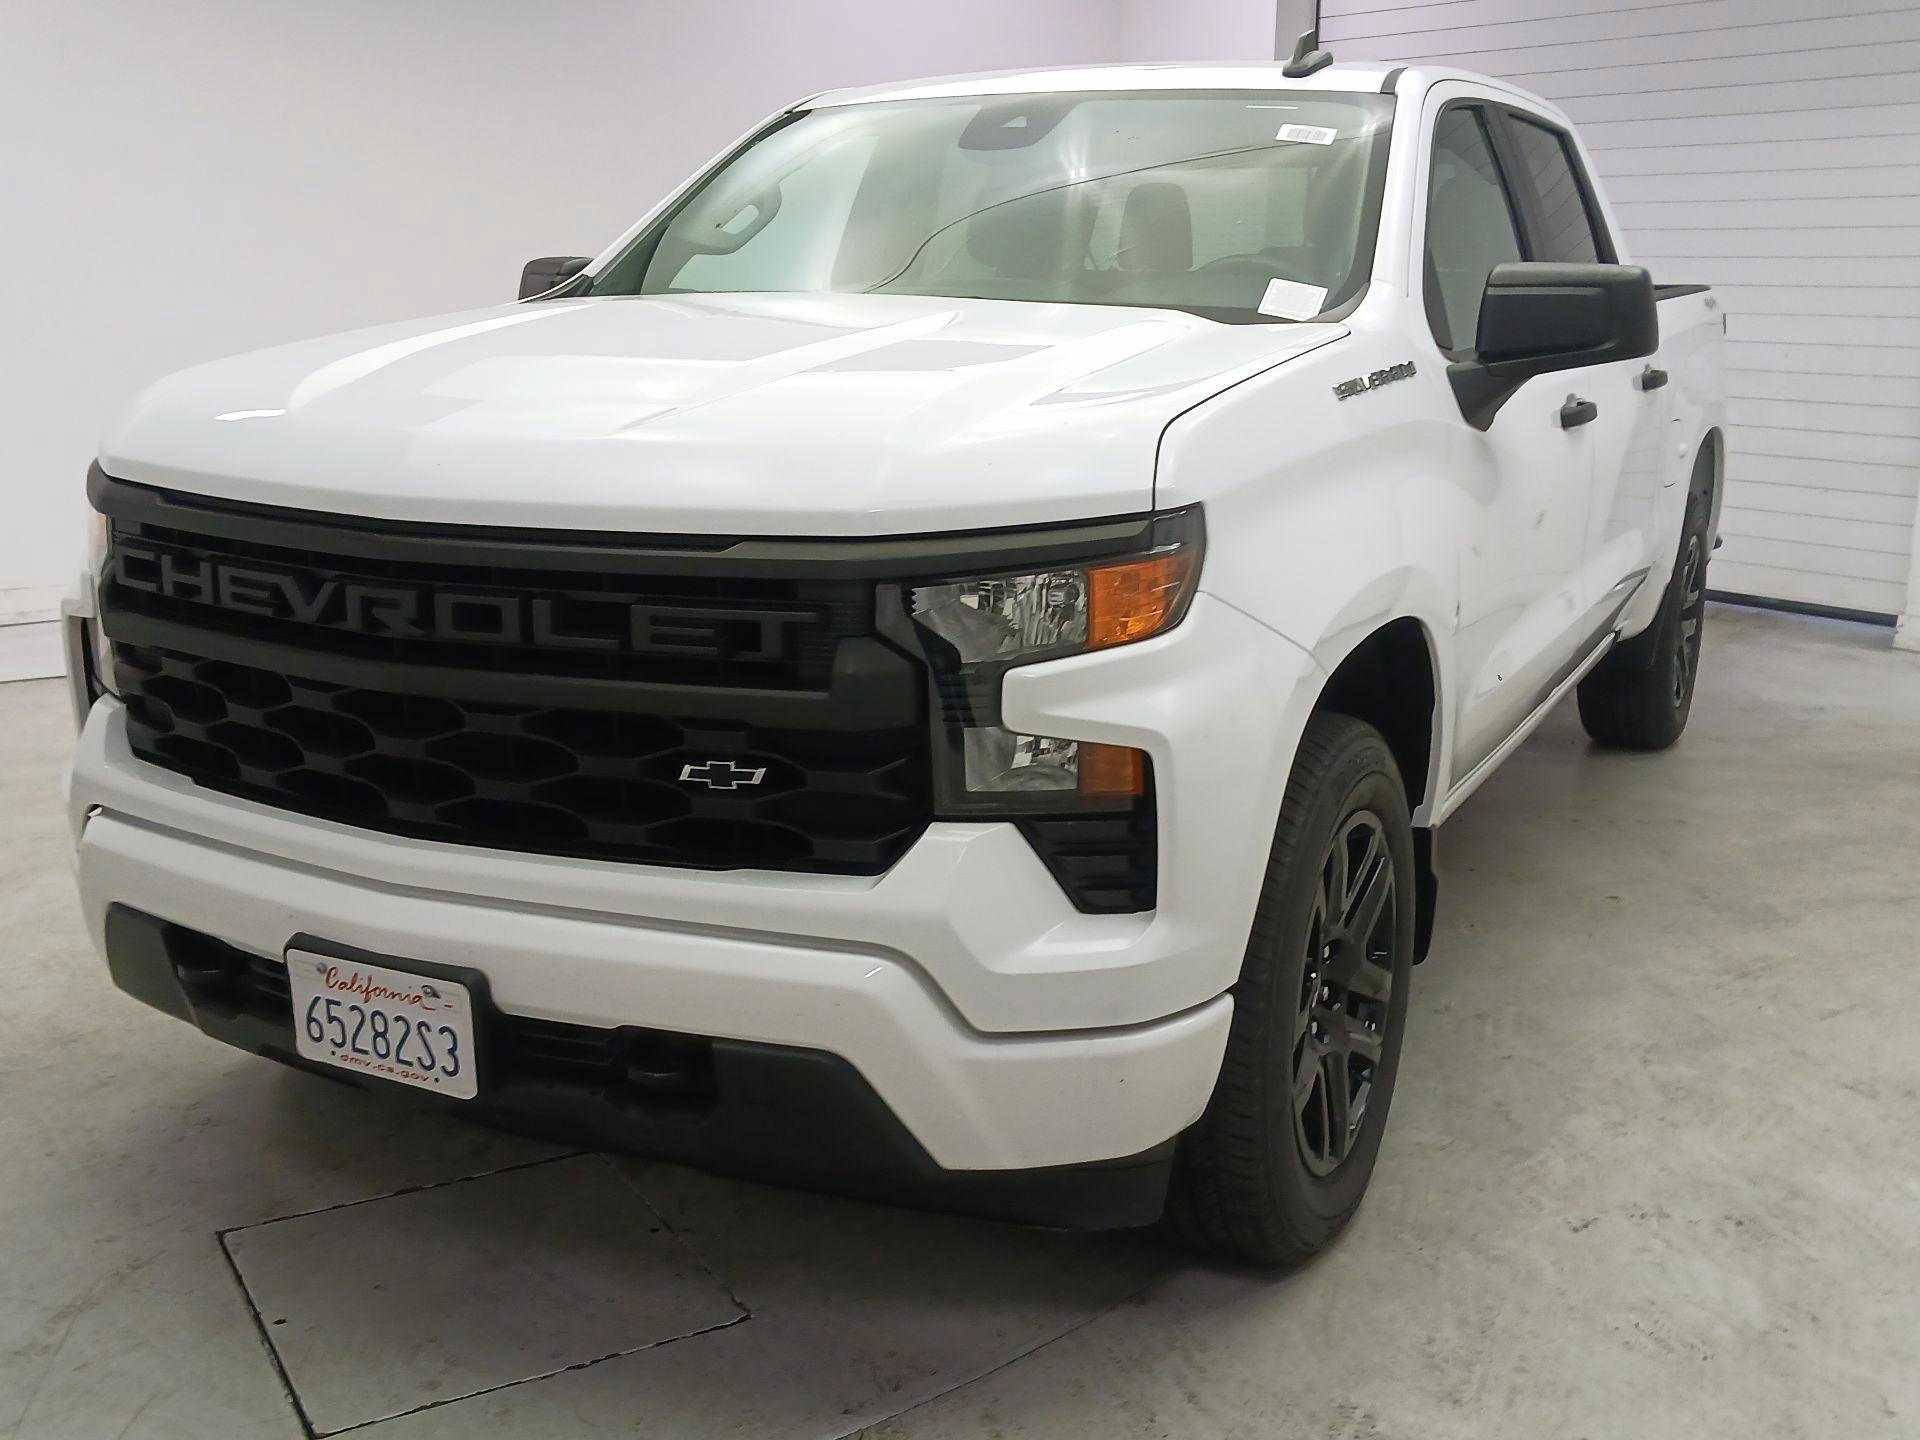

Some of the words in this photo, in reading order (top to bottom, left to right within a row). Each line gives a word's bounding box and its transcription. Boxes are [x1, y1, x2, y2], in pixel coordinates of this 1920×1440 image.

[114, 549, 820, 659] CHEVROLET
[325, 966, 436, 1011] California
[306, 995, 460, 1077] 65282S3
